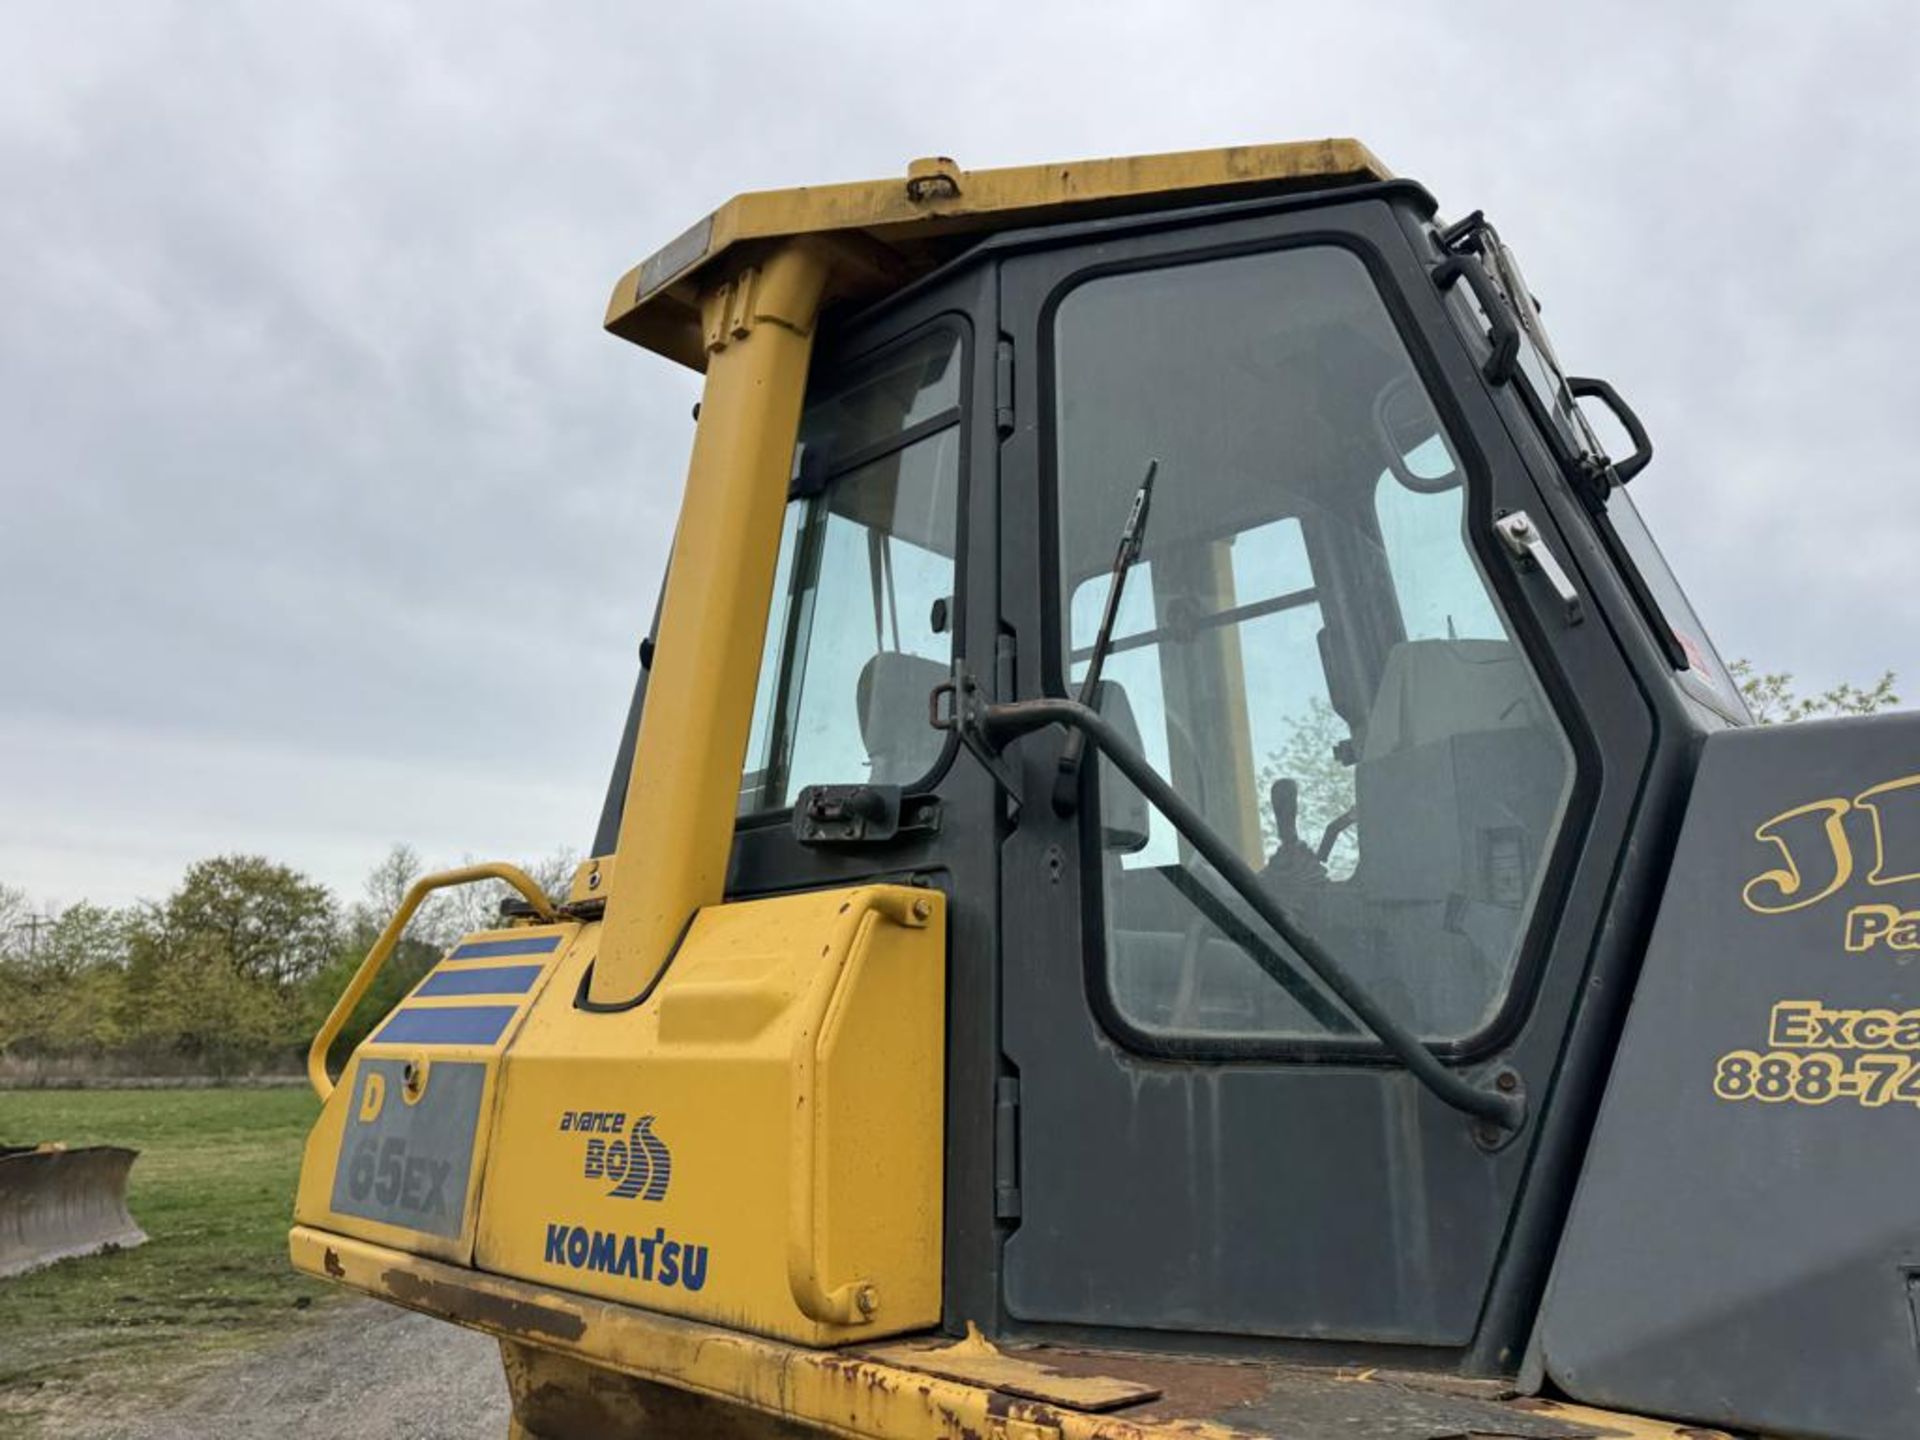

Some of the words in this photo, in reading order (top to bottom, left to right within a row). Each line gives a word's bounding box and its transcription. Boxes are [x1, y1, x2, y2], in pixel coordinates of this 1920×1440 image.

[359, 1072, 385, 1123] D
[560, 1112, 626, 1133] avance
[349, 1137, 451, 1216] 65EX
[544, 1223, 709, 1291] KOMATSU
